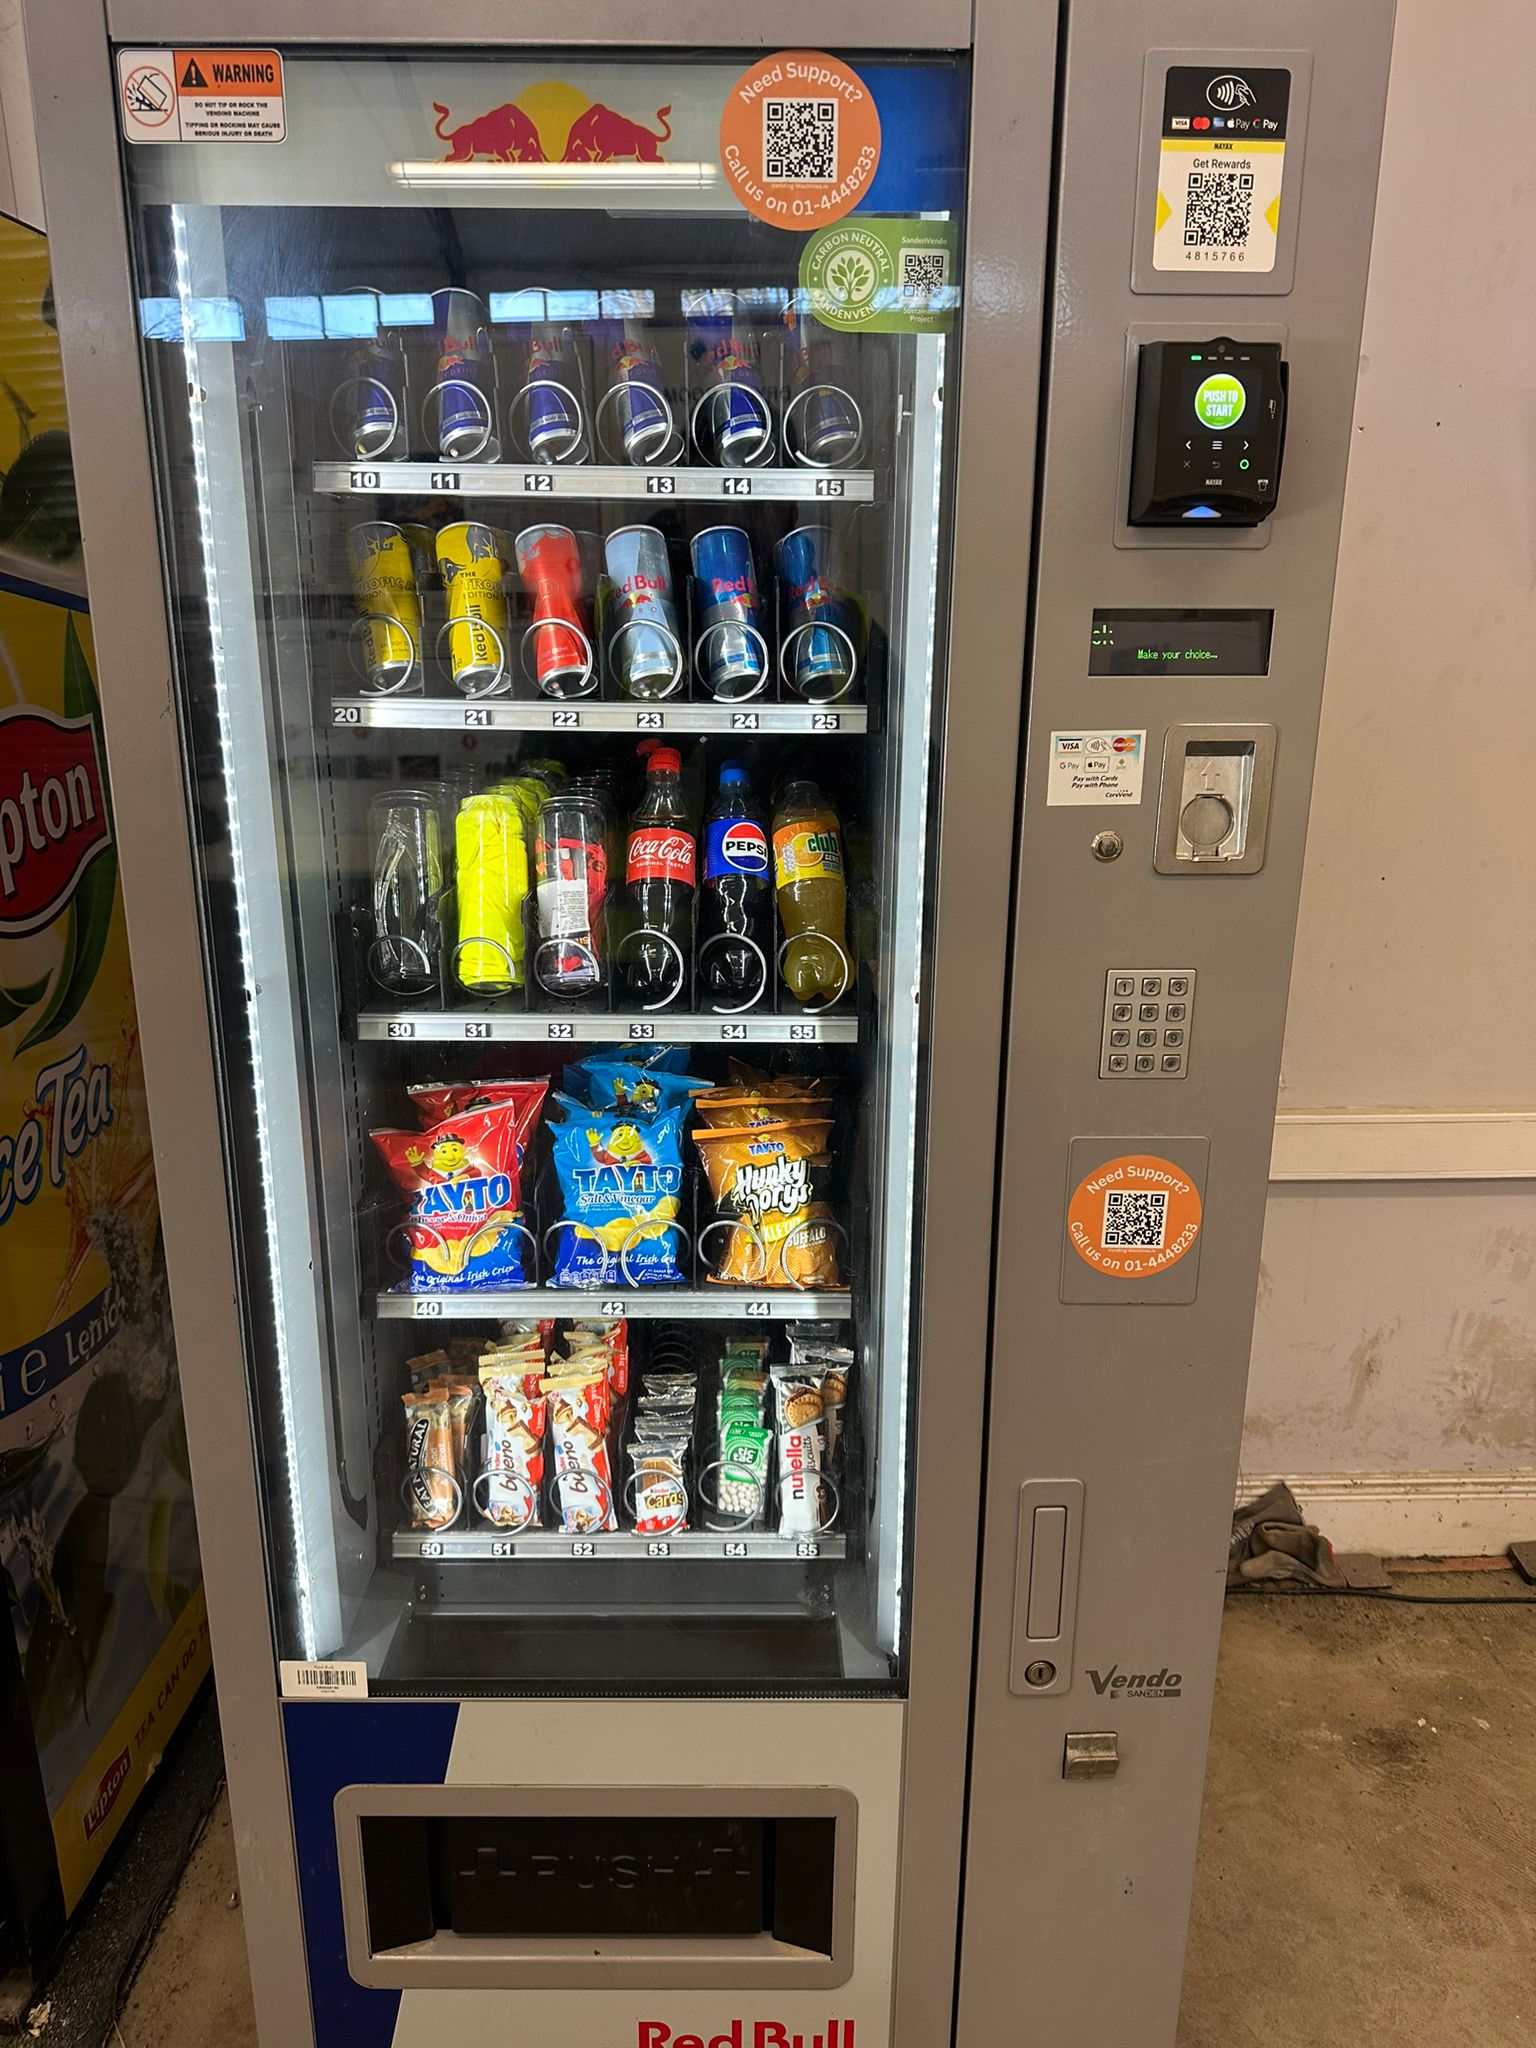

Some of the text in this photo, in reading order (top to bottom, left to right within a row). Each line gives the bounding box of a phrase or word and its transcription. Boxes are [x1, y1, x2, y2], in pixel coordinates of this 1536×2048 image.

[212, 64, 275, 83] WARNING
[739, 62, 863, 104] Need Support?
[1235, 118, 1250, 131] Pay
[1262, 119, 1279, 131] Pay
[1193, 158, 1251, 169] Get Rewards
[724, 145, 876, 216] Call us on 01-4448233
[812, 231, 890, 273] CARBON NEUTRAL
[1185, 251, 1245, 262] 4815766
[909, 315, 934, 324] Project
[1202, 390, 1239, 402] PUSH TO
[1205, 404, 1233, 417] START
[352, 473, 378, 488] 10
[431, 474, 457, 489] 11
[525, 476, 551, 491] 12
[647, 477, 673, 493] 13
[724, 478, 750, 494] 14
[817, 480, 842, 495] 15
[634, 575, 666, 592] Bull
[711, 575, 745, 594] Red
[462, 591, 500, 601] EDITION
[475, 633, 488, 662] Red
[1137, 649, 1158, 659] Make
[1162, 651, 1180, 660] your
[334, 707, 359, 723] 20
[466, 709, 488, 725] 21
[553, 711, 578, 726] 22
[637, 713, 662, 728] 23
[733, 714, 758, 729] 24
[814, 714, 839, 729] 25
[1093, 761, 1107, 769] Pay
[725, 840, 767, 857] PEPSI
[807, 830, 839, 854] club
[629, 836, 694, 865] Coca-Cola
[635, 860, 684, 869] ORIGINAL TASTE
[1122, 983, 1182, 992] 1 2 3
[1118, 1008, 1180, 1018] 4 5 6
[389, 1023, 412, 1037] 30
[466, 1023, 488, 1038] 31
[549, 1025, 572, 1038] 32
[631, 1025, 653, 1039] 33
[722, 1026, 745, 1039] 34
[791, 1026, 814, 1039] 35
[1117, 1034, 1177, 1043] 7 8 9
[1141, 1059, 1149, 1068] 0
[36, 1044, 111, 1185] Tea
[748, 1141, 785, 1156] TAYTO
[573, 1164, 682, 1194] TAYTO
[732, 1155, 809, 1202] Hunky
[1086, 1165, 1190, 1195] Need Support?
[1071, 1221, 1198, 1272] Call us on 01-4448233
[576, 1253, 659, 1266] The Irish
[427, 1274, 465, 1288] Original
[466, 1270, 491, 1286] Irish
[417, 1302, 439, 1315] 40
[601, 1302, 624, 1315] 42
[747, 1303, 770, 1316] 44
[733, 1453, 754, 1464] tac
[786, 1434, 804, 1500] nutella
[415, 1485, 433, 1510] EAT
[420, 1543, 441, 1555] 50
[492, 1543, 512, 1555] 51
[572, 1544, 594, 1556] 52
[648, 1543, 669, 1556] 53
[725, 1543, 746, 1556] 54
[798, 1543, 819, 1556] 55
[1084, 1664, 1183, 1696] Vendo
[1127, 1689, 1165, 1698] SANDEN
[85, 1639, 197, 1828] Lipton TEA CAN DO
[638, 2019, 855, 2048] Red Bull
